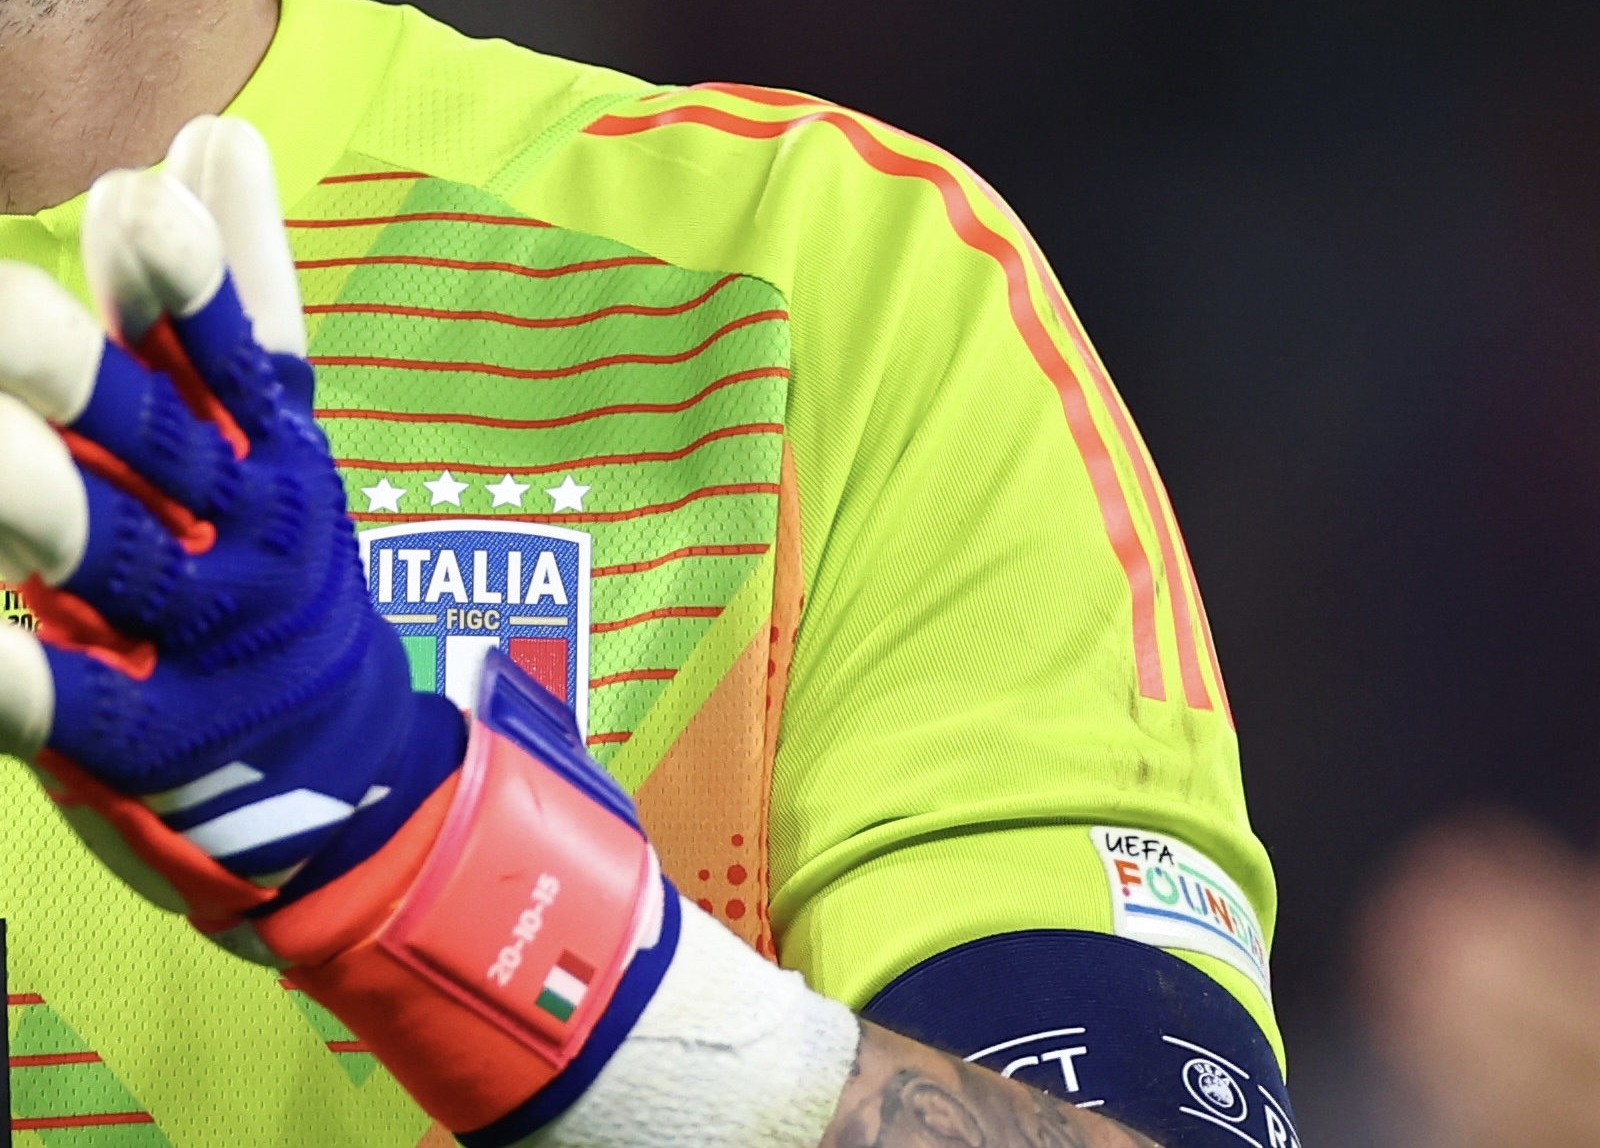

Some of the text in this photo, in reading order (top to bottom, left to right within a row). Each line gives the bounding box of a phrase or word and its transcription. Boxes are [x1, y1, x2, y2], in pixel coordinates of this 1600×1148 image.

[379, 549, 568, 605] ITALIA
[446, 608, 500, 630] FIGC
[1105, 833, 1175, 866] UEFA
